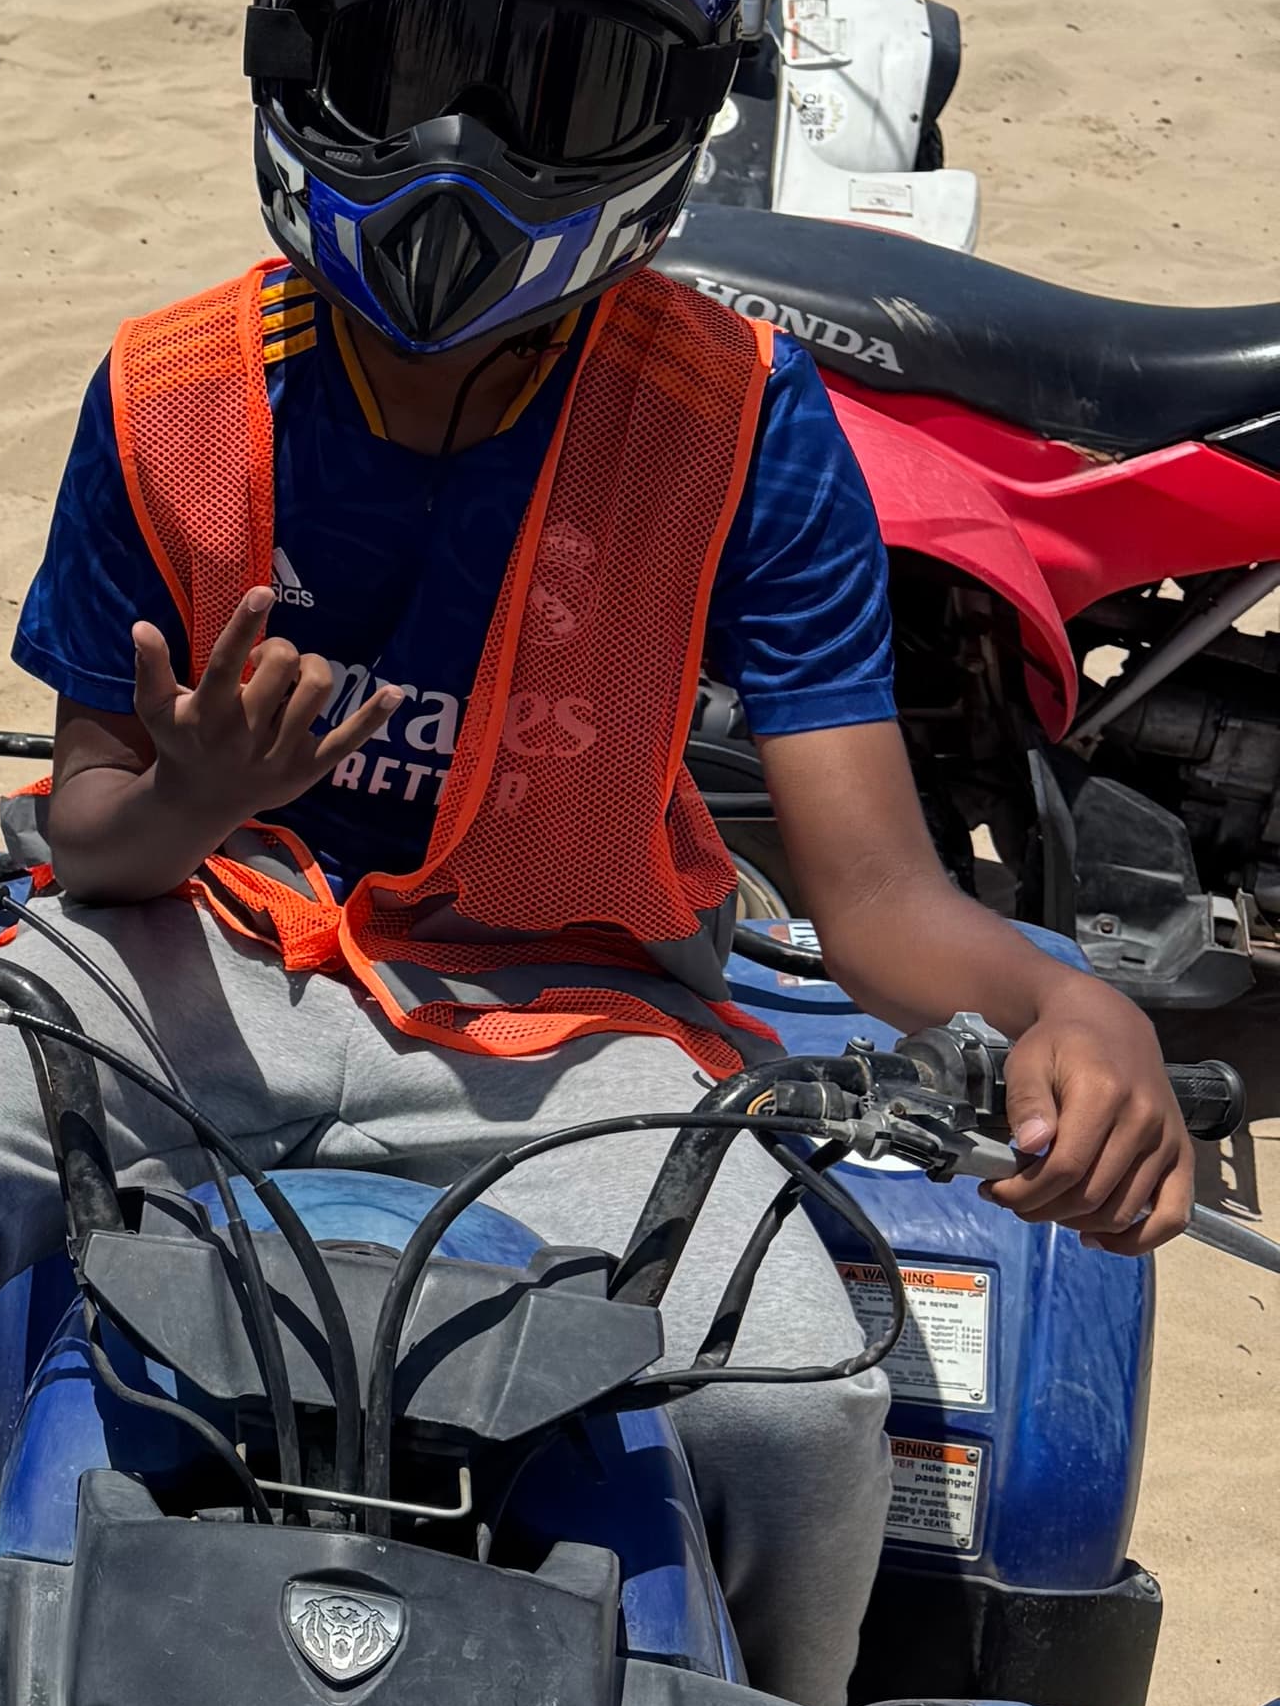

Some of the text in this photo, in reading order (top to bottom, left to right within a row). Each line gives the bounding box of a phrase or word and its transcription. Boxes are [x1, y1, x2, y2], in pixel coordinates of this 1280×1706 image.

[696, 277, 904, 374] HONDA
[271, 584, 315, 609] das
[863, 1268, 935, 1286] WANING
[891, 1441, 944, 1459] RNING
[921, 1463, 942, 1472] ride
[949, 1467, 961, 1475] as
[915, 1473, 974, 1489] passenger.
